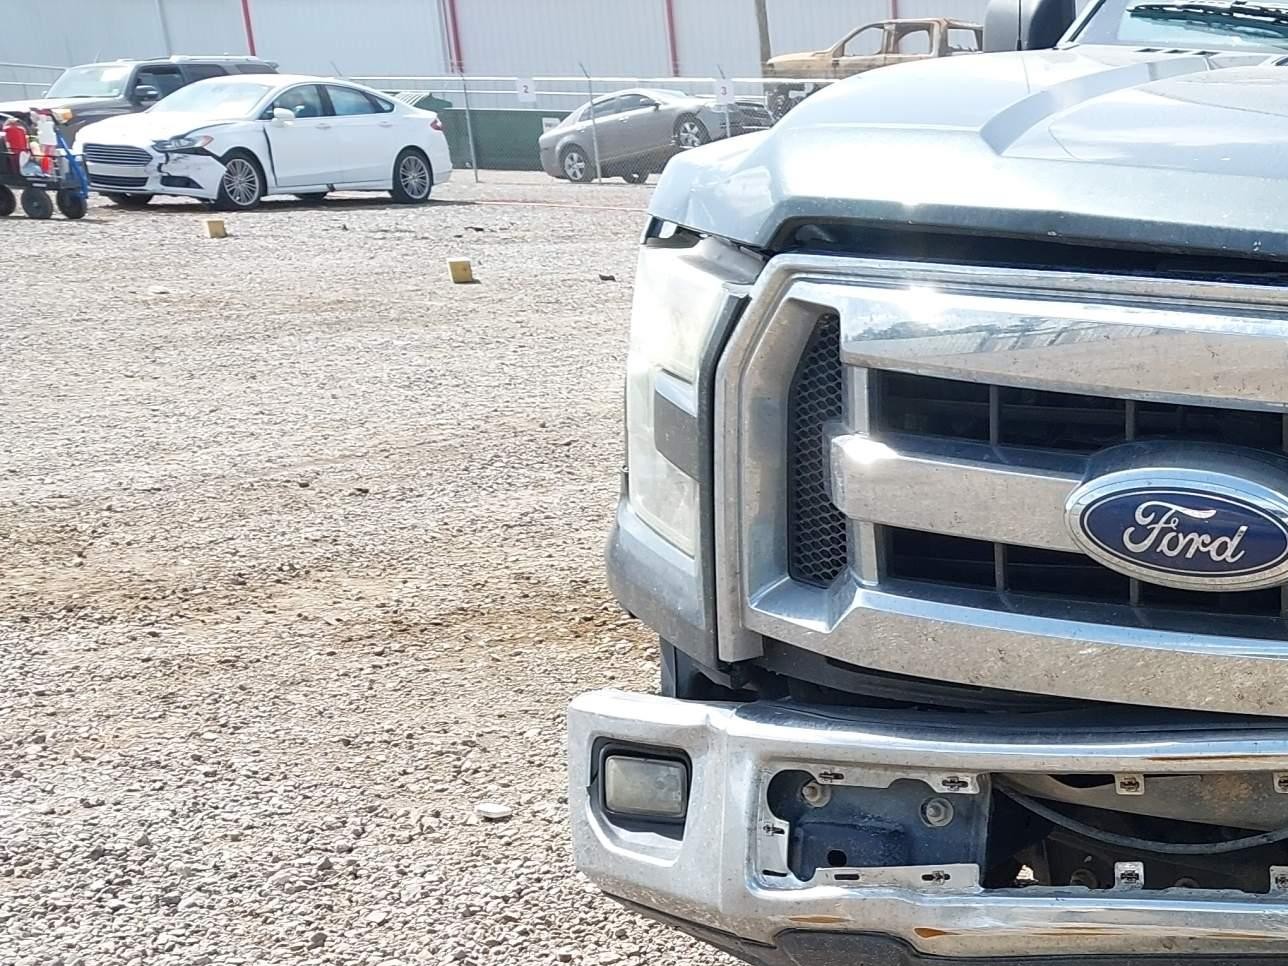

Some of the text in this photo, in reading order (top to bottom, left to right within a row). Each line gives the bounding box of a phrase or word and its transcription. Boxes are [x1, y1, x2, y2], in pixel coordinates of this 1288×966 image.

[522, 84, 529, 94] 2
[720, 86, 727, 96] 3
[1122, 500, 1248, 563] Ford
